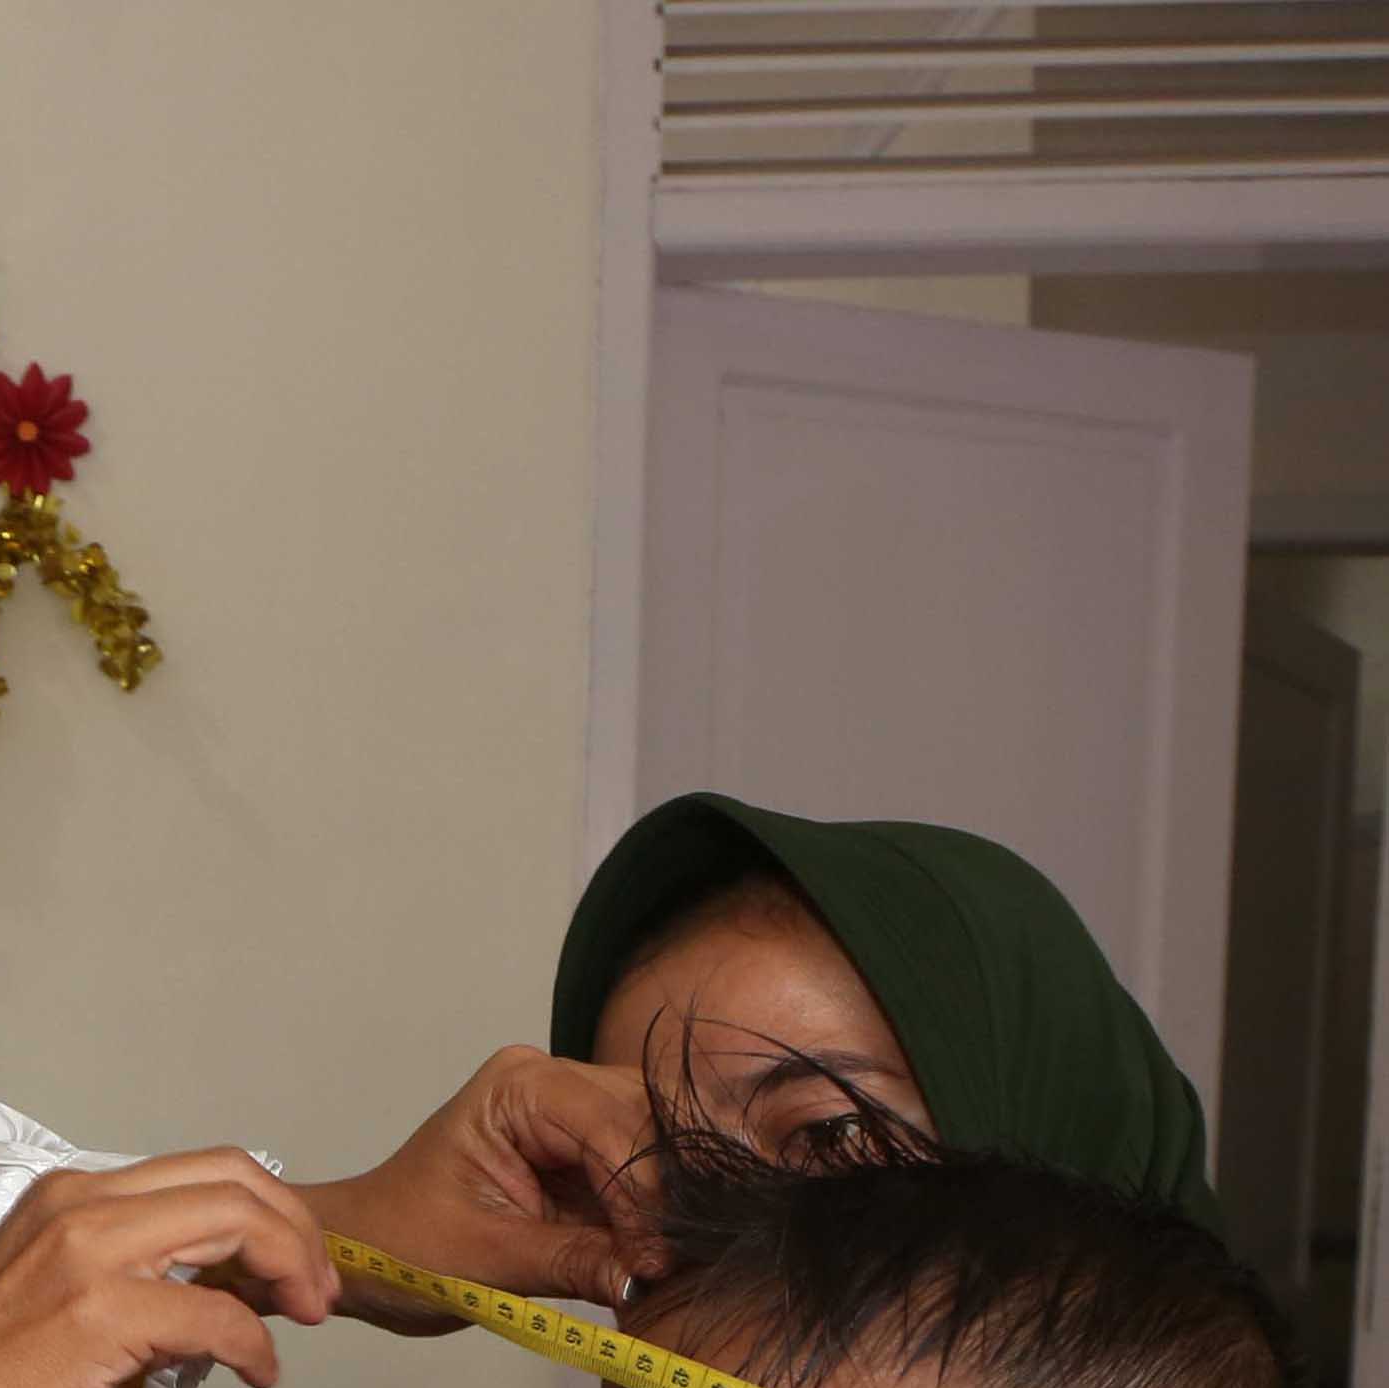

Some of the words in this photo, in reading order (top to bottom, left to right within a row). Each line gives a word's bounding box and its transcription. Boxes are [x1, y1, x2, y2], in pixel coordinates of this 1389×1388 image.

[496, 1300, 516, 1321] 47
[529, 1312, 550, 1334] 46
[564, 1325, 585, 1347] 45
[599, 1339, 619, 1359] 44
[635, 1353, 656, 1374] 43
[670, 1366, 692, 1388] 42
